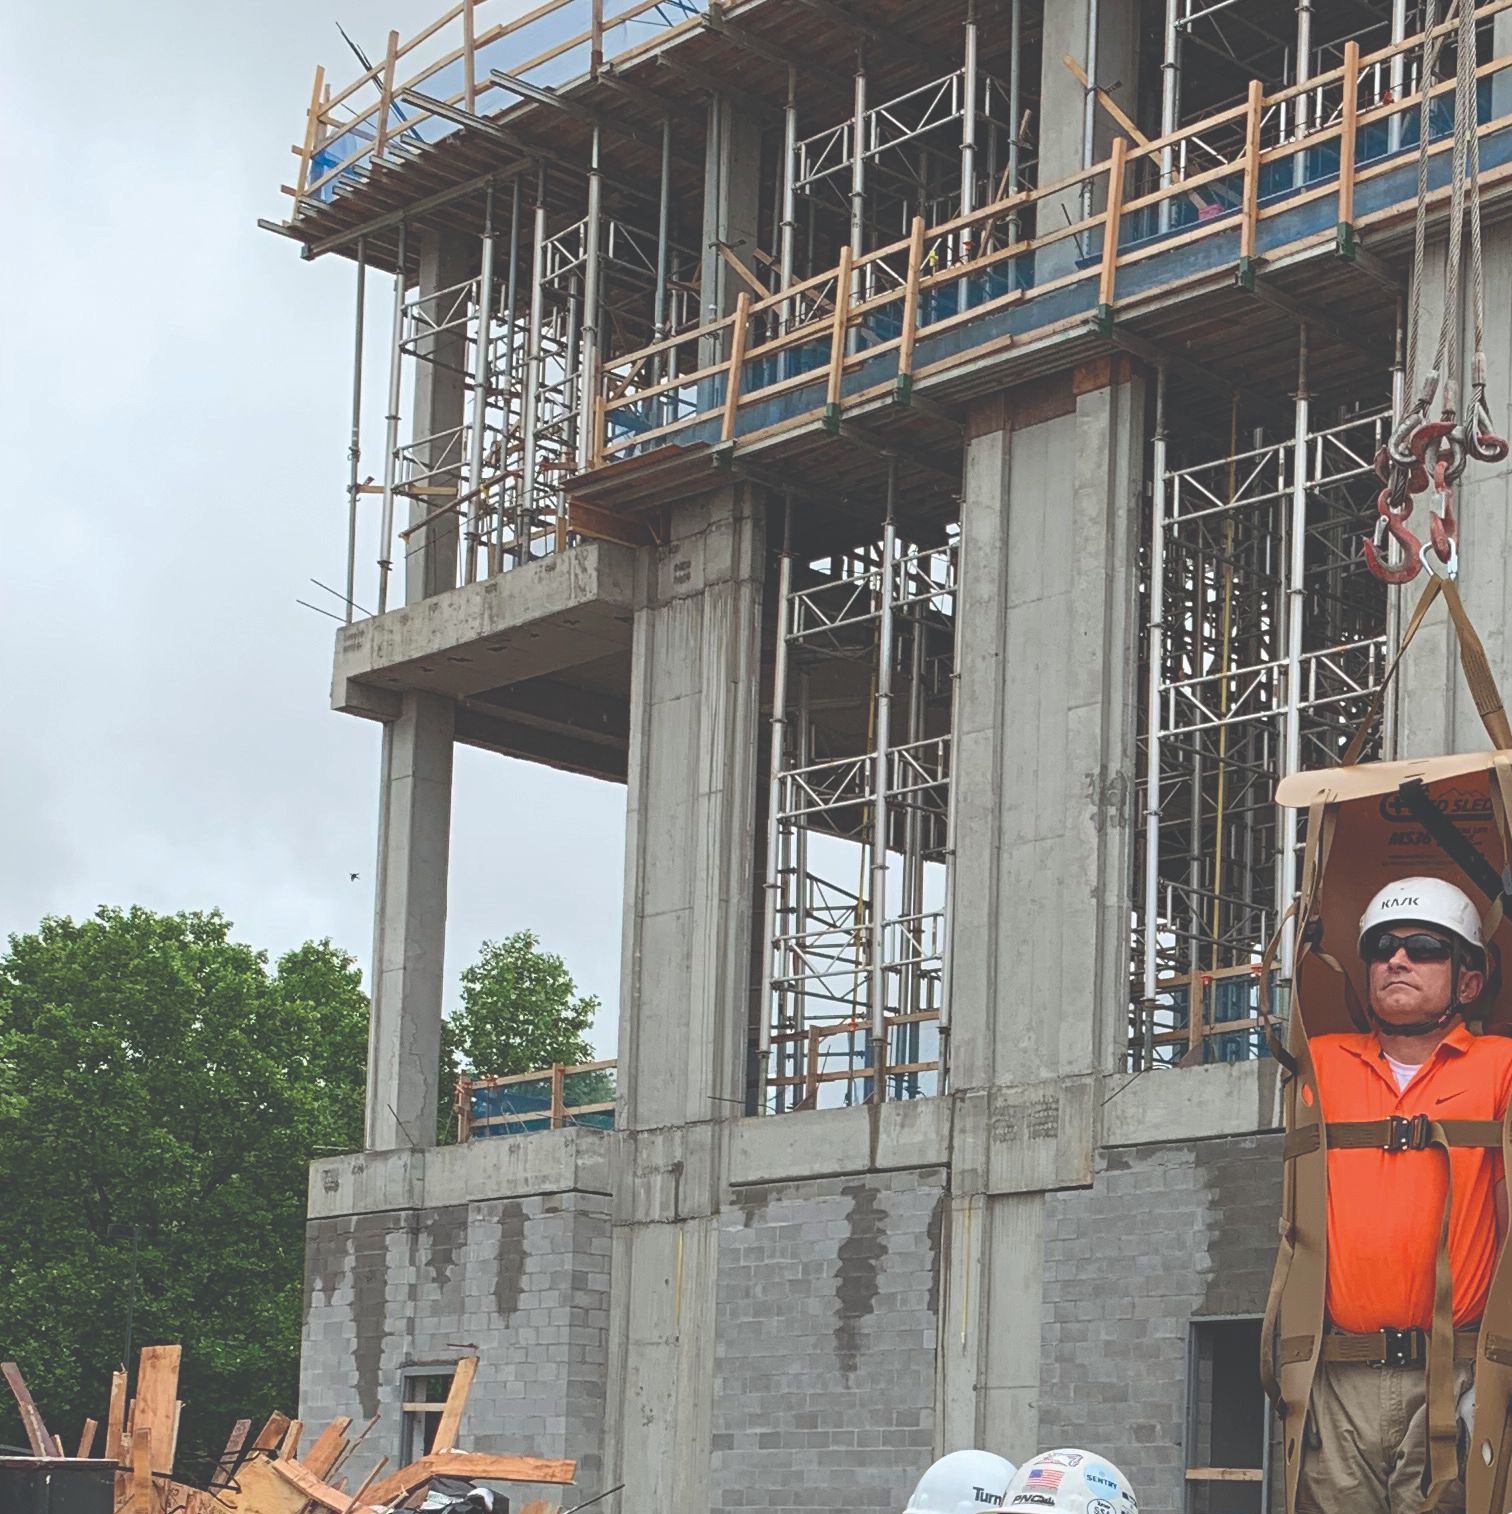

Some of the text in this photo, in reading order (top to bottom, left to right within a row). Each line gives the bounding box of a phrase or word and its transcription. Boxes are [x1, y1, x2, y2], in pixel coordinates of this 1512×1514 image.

[1381, 897, 1420, 910] KASK
[1086, 1474, 1118, 1491] SENTRY
[972, 1486, 1002, 1506] Turn
